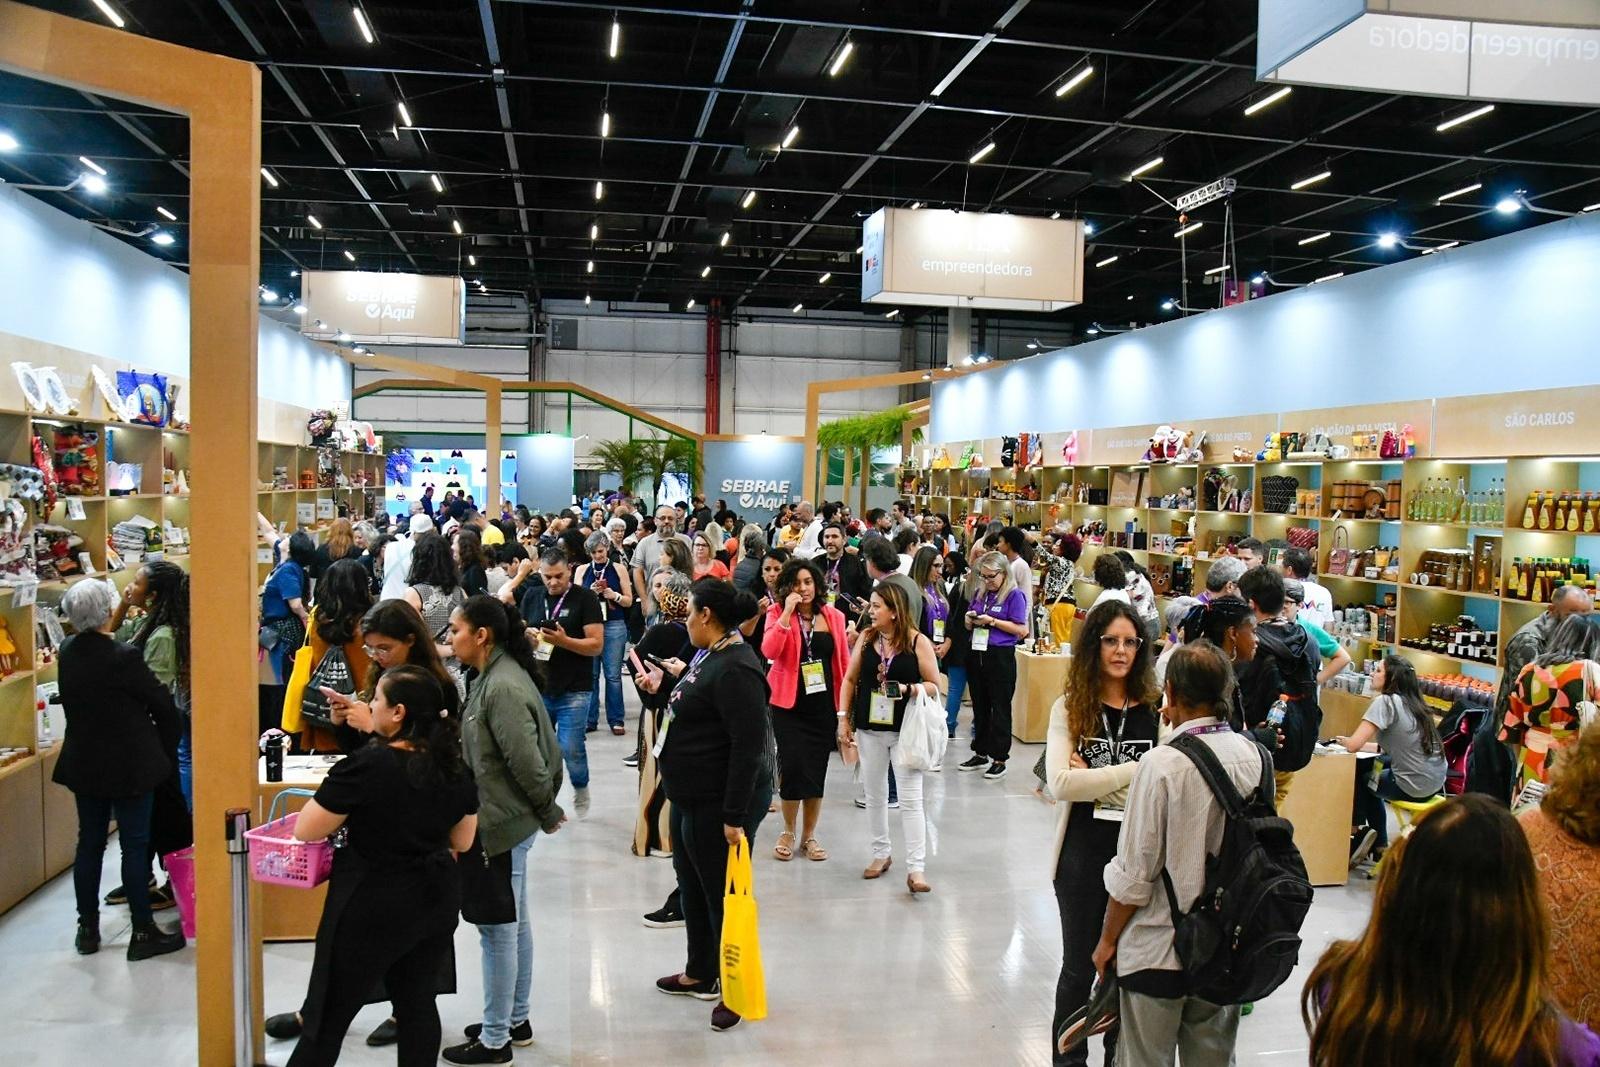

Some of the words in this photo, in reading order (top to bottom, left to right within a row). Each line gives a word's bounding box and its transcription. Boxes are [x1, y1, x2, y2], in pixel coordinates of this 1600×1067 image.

[922, 258, 1032, 277] empreendedora
[381, 304, 416, 322] Aqui
[1505, 413, 1527, 428] SÃO
[1529, 411, 1575, 425] CARLOS
[721, 479, 790, 493] SEBRAE
[754, 495, 788, 511] Aqui
